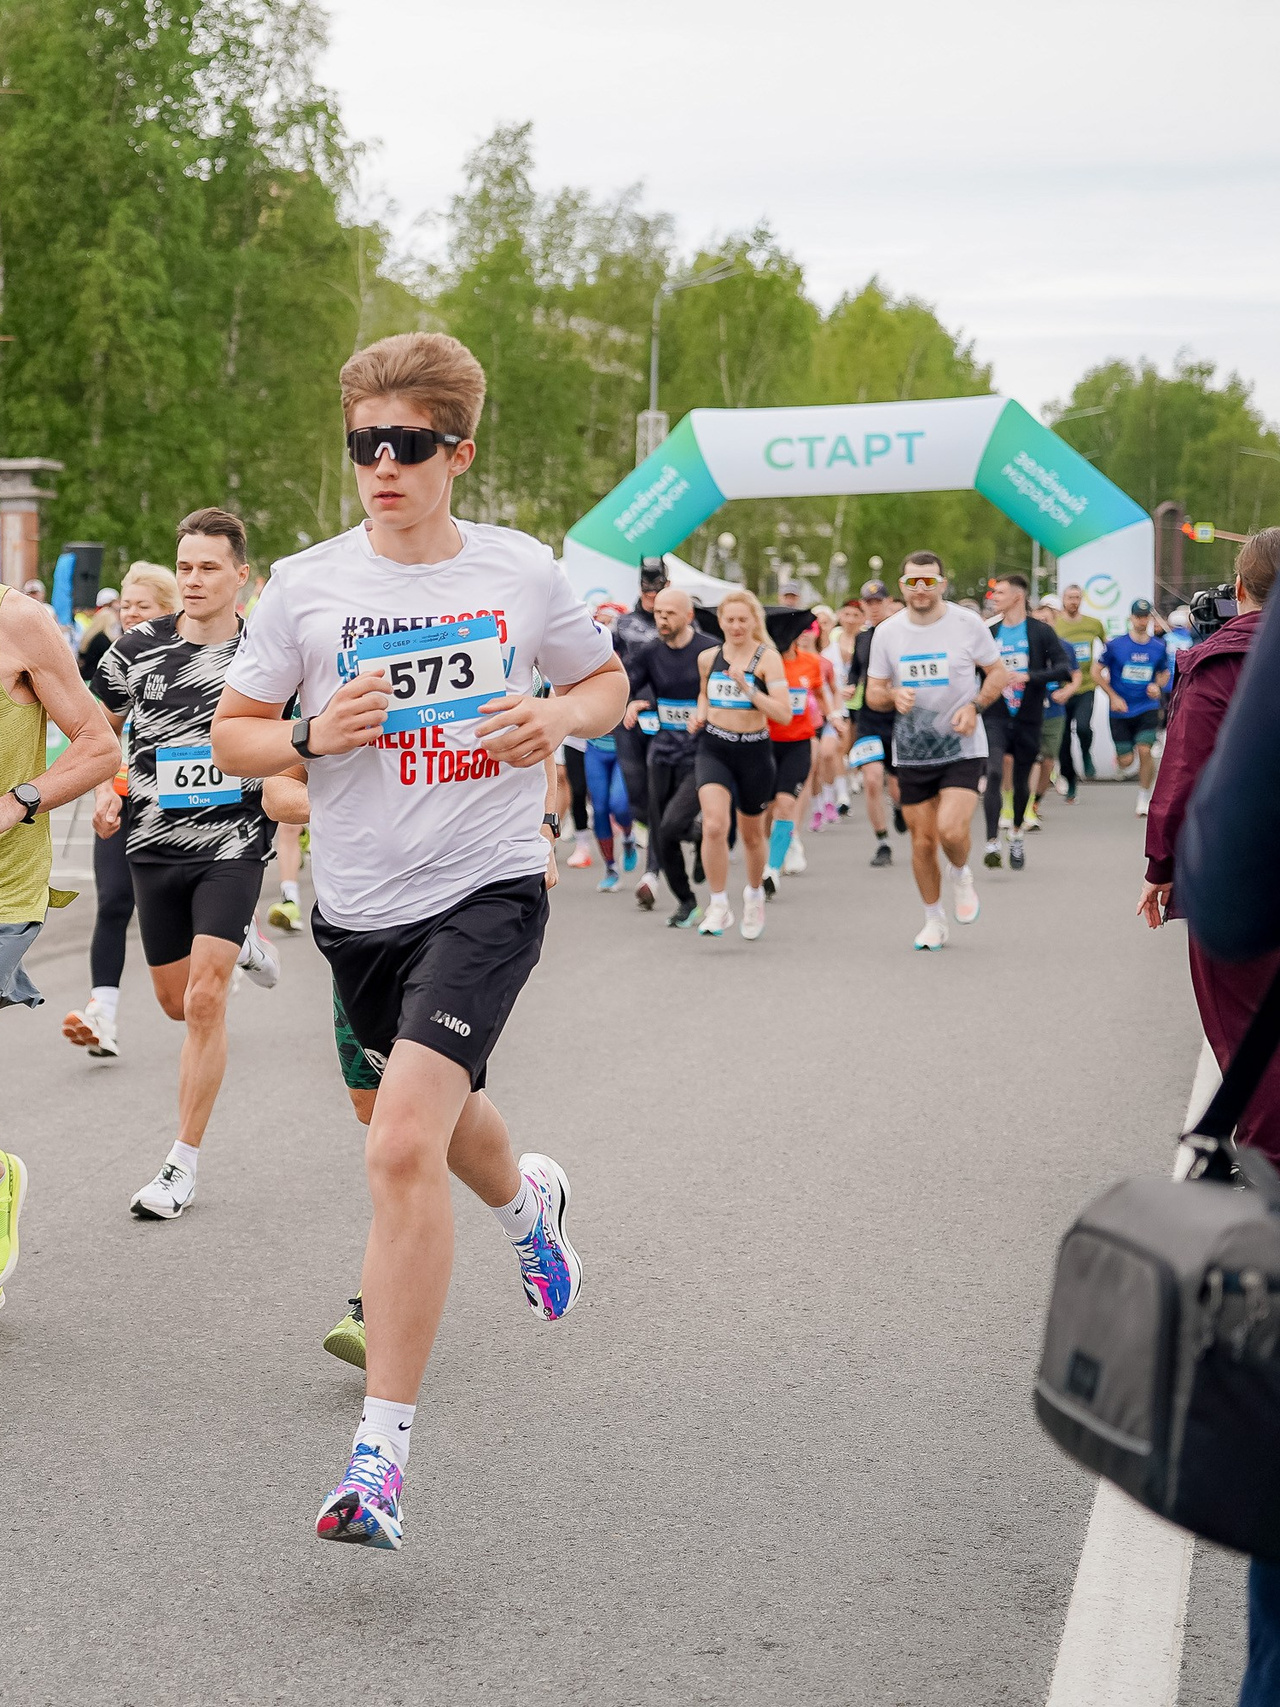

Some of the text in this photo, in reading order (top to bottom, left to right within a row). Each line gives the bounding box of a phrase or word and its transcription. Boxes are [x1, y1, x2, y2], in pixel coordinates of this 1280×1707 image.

[763, 431, 925, 470] СТАРТ
[389, 652, 475, 700] 573
[910, 664, 938, 677] 818
[142, 691, 164, 700] NER
[144, 683, 168, 692] RUN
[174, 764, 224, 787] 620
[400, 751, 417, 786] С
[429, 1009, 472, 1037] JAKO
